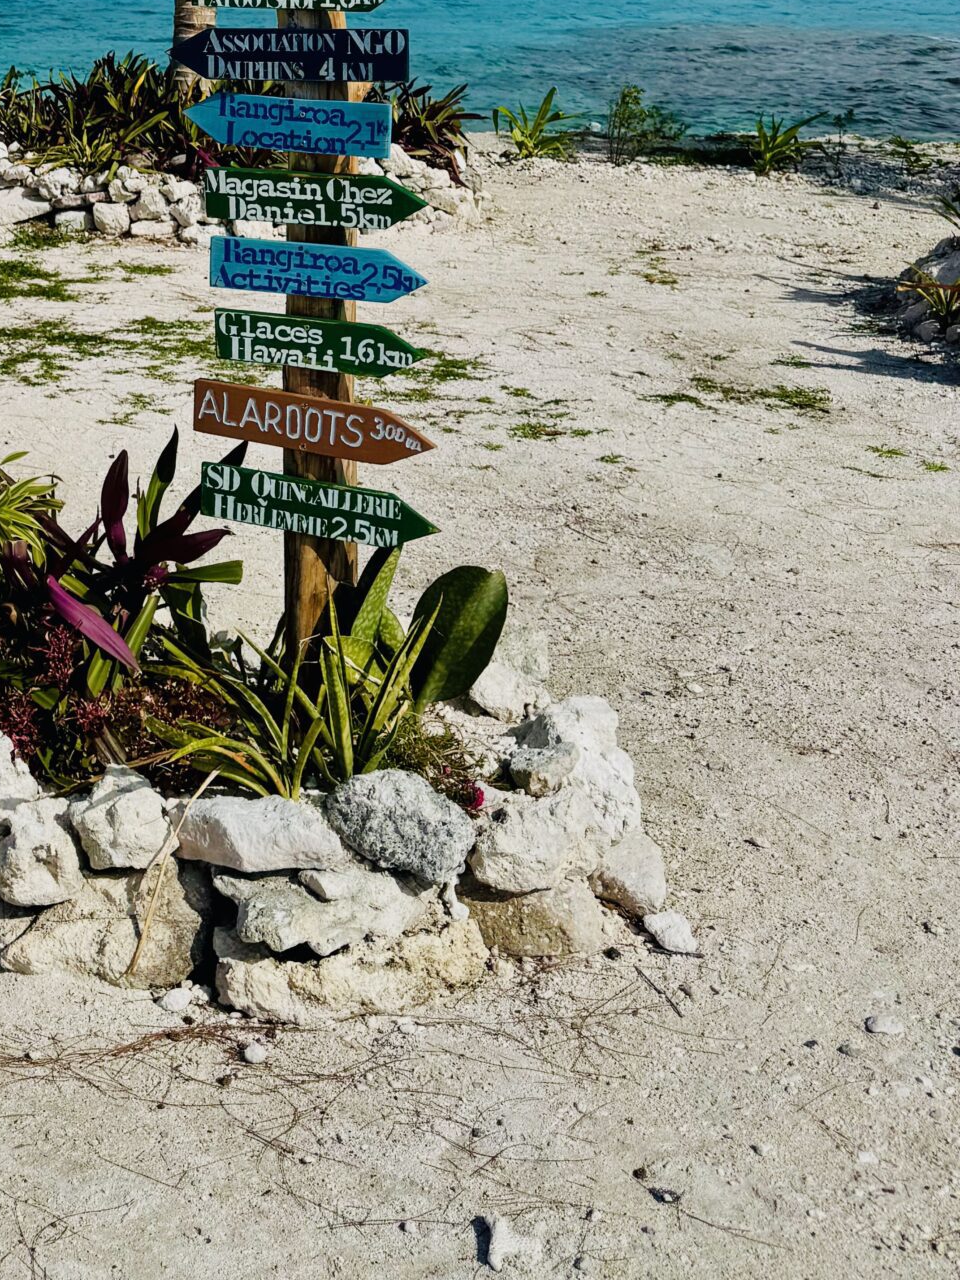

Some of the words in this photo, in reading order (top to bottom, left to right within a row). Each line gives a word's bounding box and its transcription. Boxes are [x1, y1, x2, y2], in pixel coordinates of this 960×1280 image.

[203, 30, 336, 53] ASSOCIATION
[347, 30, 405, 55] NGO
[206, 55, 304, 80] DAUPHINS
[319, 58, 335, 80] 4
[218, 92, 347, 127] Rangiroa
[226, 120, 347, 155] Location
[205, 169, 323, 201] Magasin
[326, 178, 392, 205] Chez
[223, 238, 361, 273] Rangiroa
[215, 264, 366, 299] Activities
[219, 312, 323, 345] Glaces
[230, 336, 338, 372] Hawaii
[198, 389, 364, 448] ALAROOTS
[205, 464, 240, 492] SD
